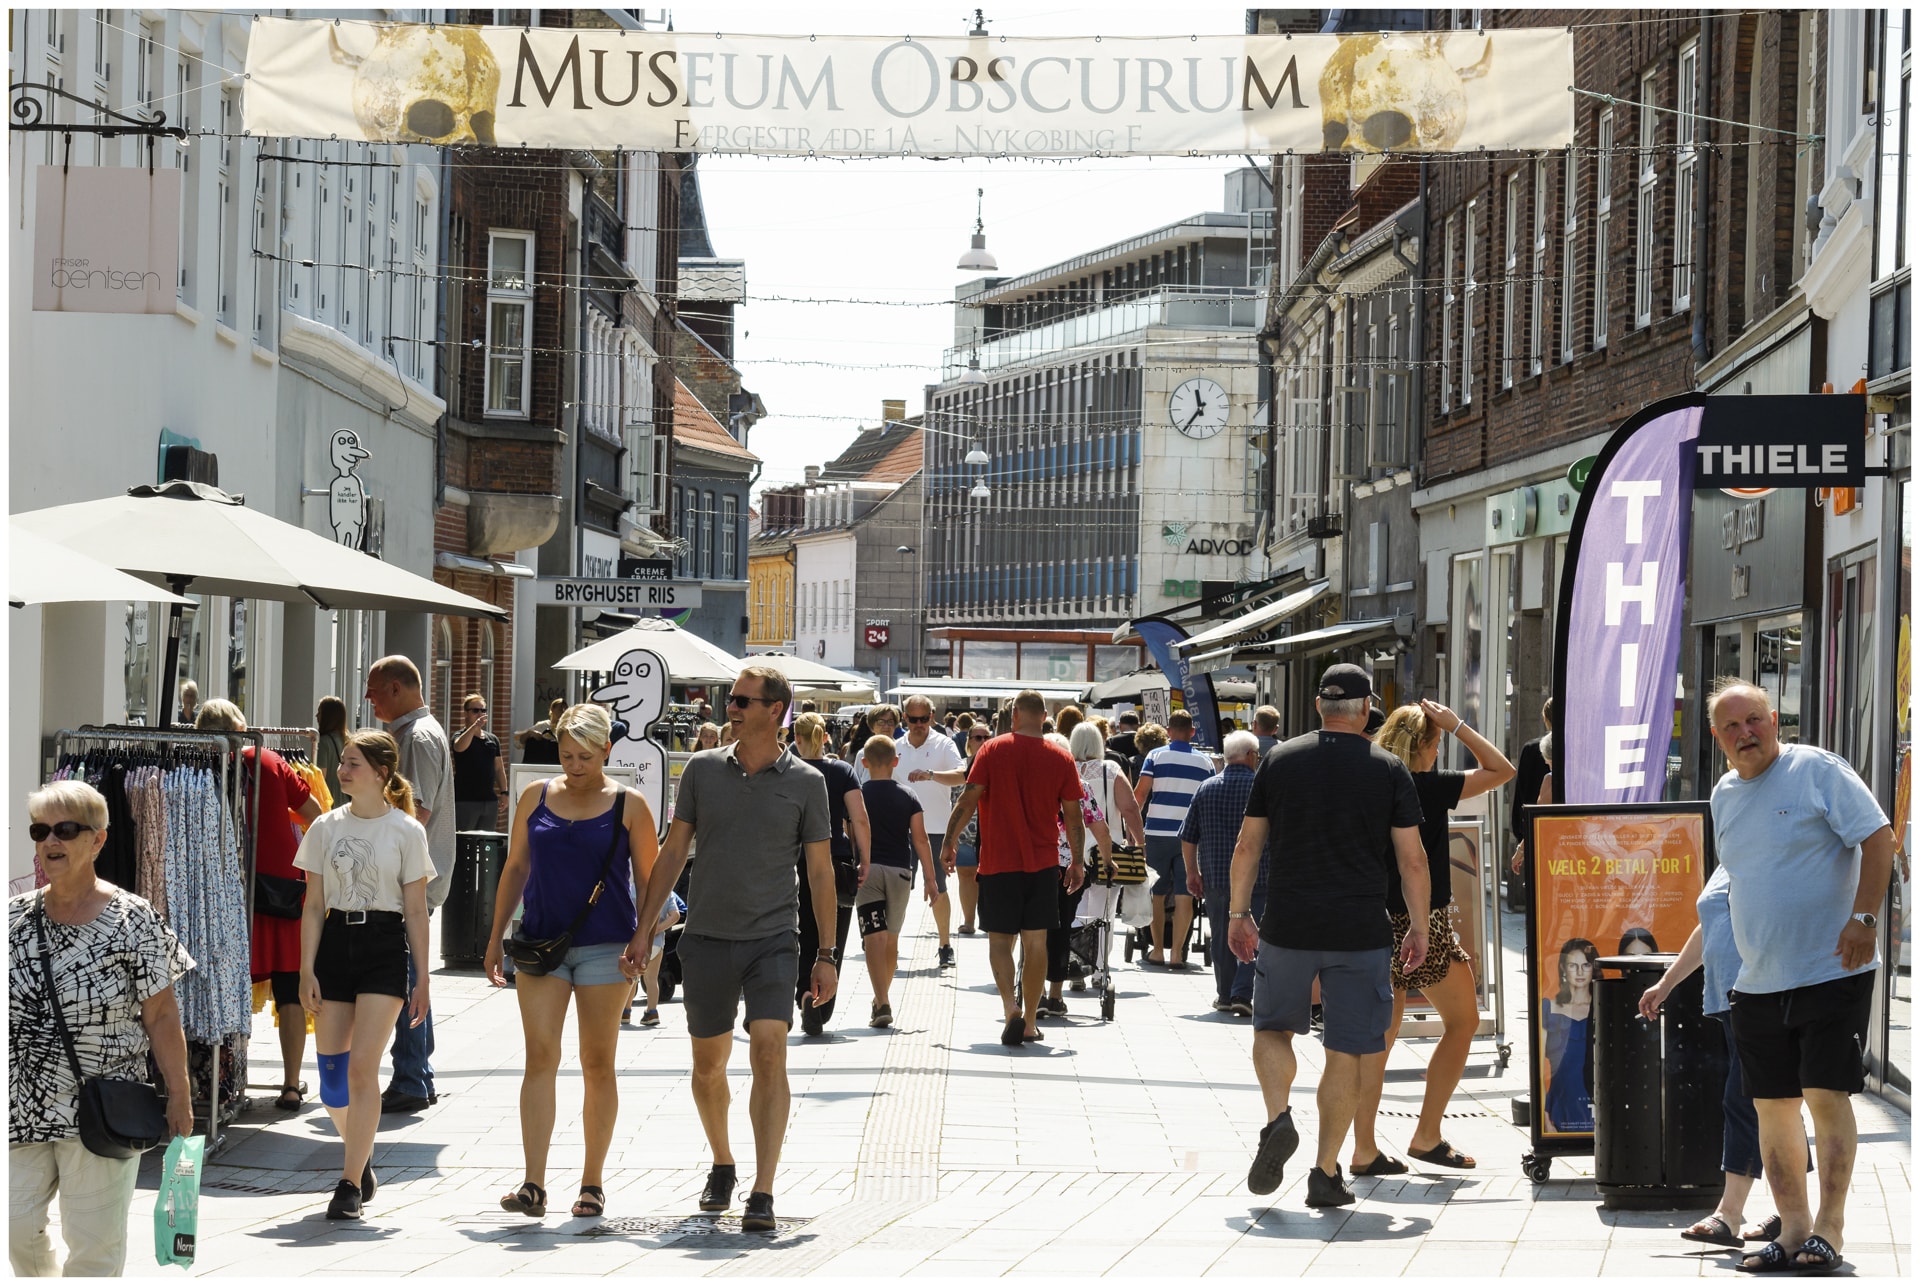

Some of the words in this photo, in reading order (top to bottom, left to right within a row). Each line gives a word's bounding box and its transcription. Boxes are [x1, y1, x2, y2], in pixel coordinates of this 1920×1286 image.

[506, 32, 844, 111] MUSEUM
[872, 40, 1310, 118] OBSCURUM
[886, 124, 919, 151] 1A
[955, 124, 1115, 152] NYKØBING
[1125, 124, 1142, 152] F
[54, 258, 90, 267] FRISØR
[51, 257, 161, 291] bentsen
[1696, 444, 1848, 475] THIELE
[634, 567, 665, 576] CREME
[555, 583, 642, 603] BRYGHUSET
[648, 586, 675, 604] RIIS
[868, 630, 888, 643] 24
[1548, 859, 1587, 876] VÆLG
[1591, 855, 1601, 875] 2
[1605, 858, 1649, 875] BETAL
[1653, 857, 1680, 874] FOR
[1684, 854, 1691, 873] 1
